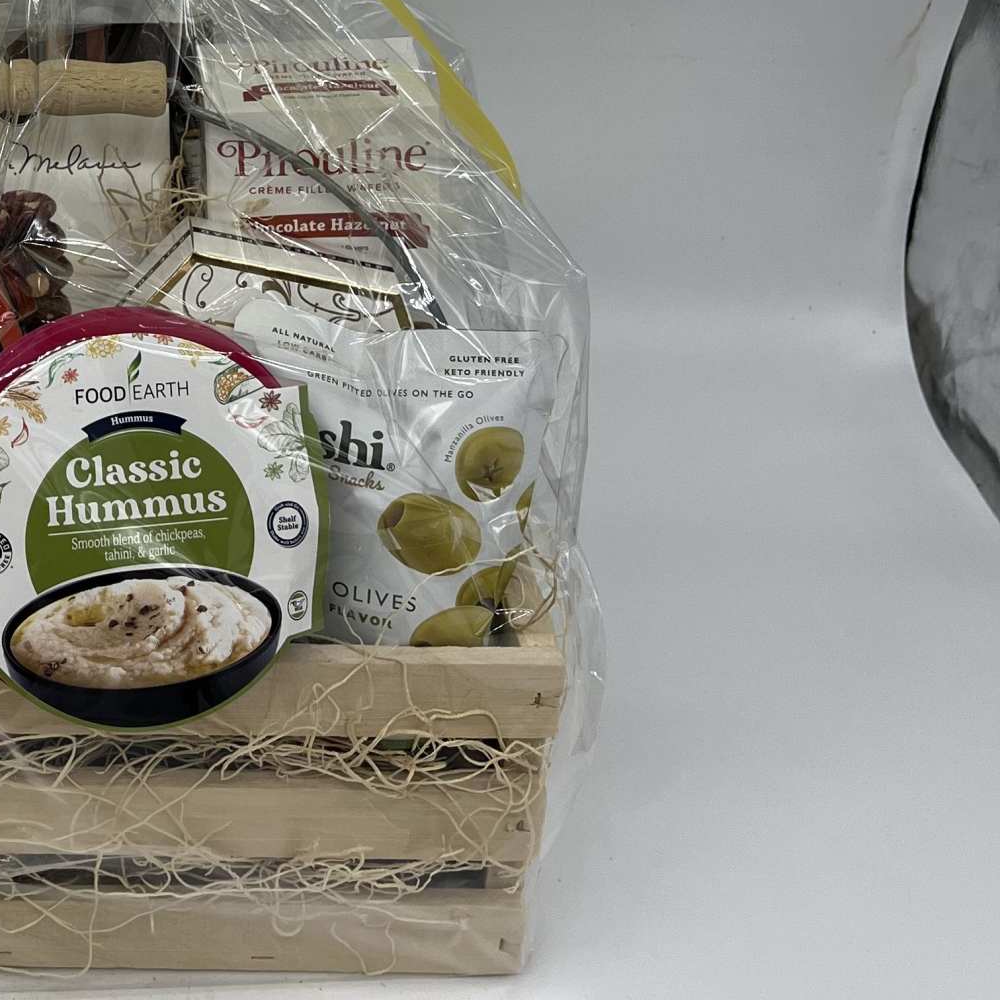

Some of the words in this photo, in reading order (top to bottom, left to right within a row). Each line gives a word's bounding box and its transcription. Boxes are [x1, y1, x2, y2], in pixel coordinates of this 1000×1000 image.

[217, 138, 428, 177] Pirouline
[249, 184, 293, 195] CRÈME
[331, 217, 406, 232] Hazenut
[271, 326, 291, 337] ALL
[293, 333, 335, 353] NATURAL
[449, 355, 490, 364] GLUTEN
[494, 355, 520, 364] FREE
[306, 371, 339, 386] GREEN
[342, 382, 373, 398] PITTED
[412, 389, 428, 398] ON
[434, 390, 455, 399] THE
[457, 390, 474, 399] GO
[444, 368, 471, 377] KETO
[475, 368, 525, 378] FRIENDLY
[75, 386, 126, 405] FOOD
[133, 381, 189, 400] EARTH
[110, 414, 154, 426] Hummus
[444, 423, 473, 463] Manzanilla
[475, 414, 505, 426] Olives
[66, 450, 202, 489] Classic
[328, 463, 385, 491] Snacks
[46, 490, 227, 527] Hummus
[278, 515, 297, 523] Shelf
[277, 522, 299, 531] Stable
[71, 535, 111, 551] Smooth
[112, 532, 140, 546] blend
[143, 531, 154, 544] of
[155, 527, 206, 543] chickpeas,
[104, 547, 135, 562] tahini,
[137, 547, 146, 559] &
[148, 543, 176, 561] garlic
[332, 581, 417, 612] OLIVES
